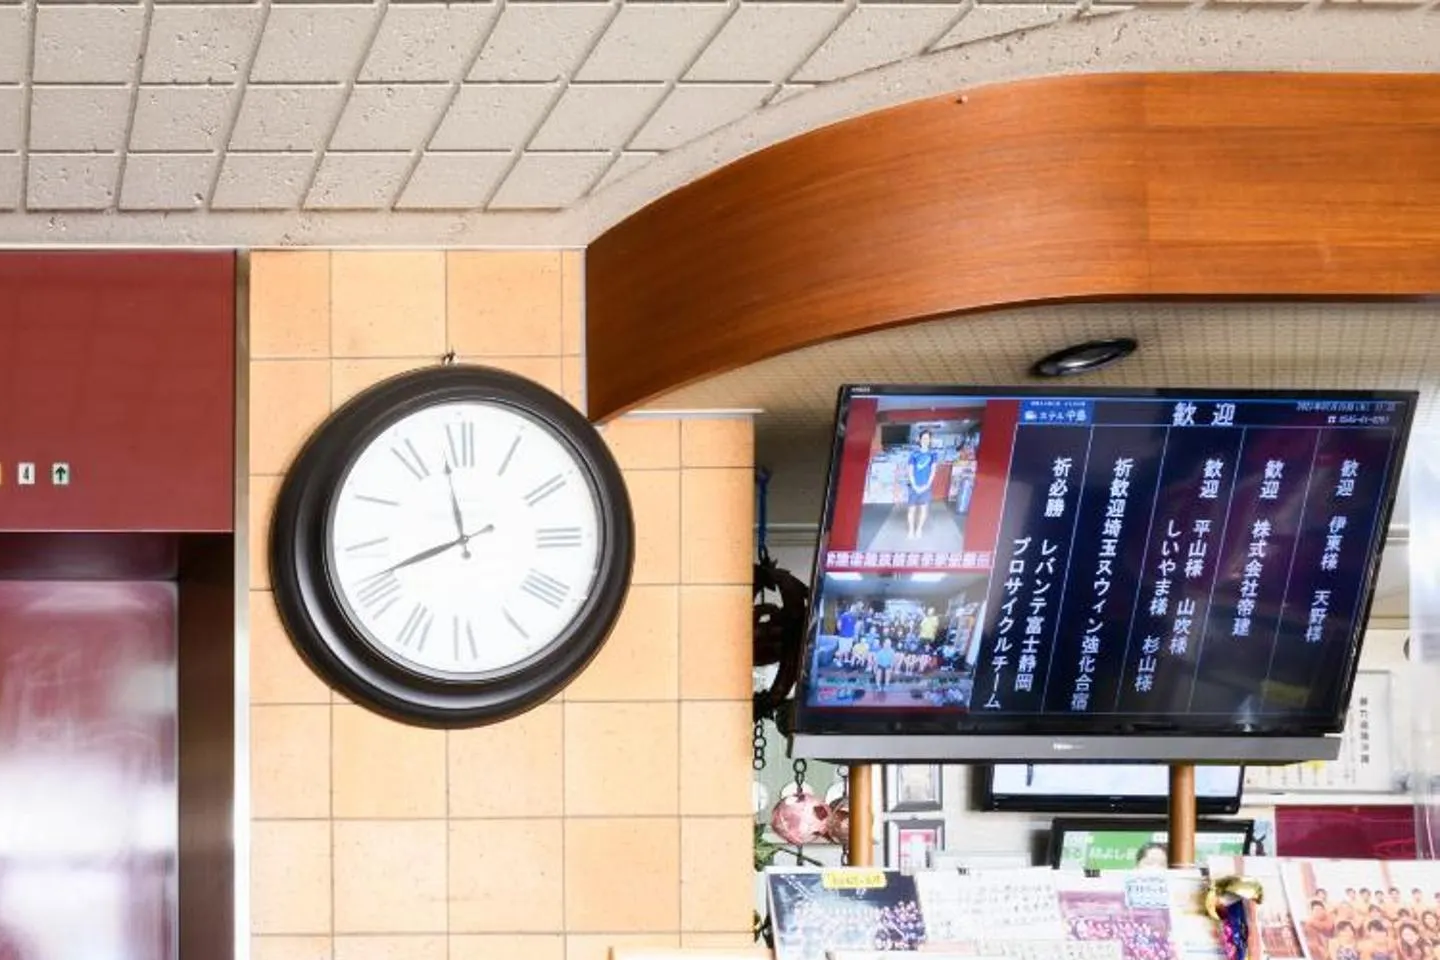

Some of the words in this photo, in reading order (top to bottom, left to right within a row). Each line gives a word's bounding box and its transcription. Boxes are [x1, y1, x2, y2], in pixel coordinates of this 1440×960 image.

[1044, 457, 1072, 518] 祈必勝
[1199, 459, 1224, 500] 歓迎
[1260, 459, 1285, 500] 歓迎
[1335, 459, 1360, 498] 歓迎
[1149, 519, 1182, 616] しいやま様
[1184, 519, 1212, 578] 平山様
[1320, 515, 1348, 571] 伊東様
[1305, 590, 1331, 643] 天野様
[1134, 635, 1160, 692] 杉山様
